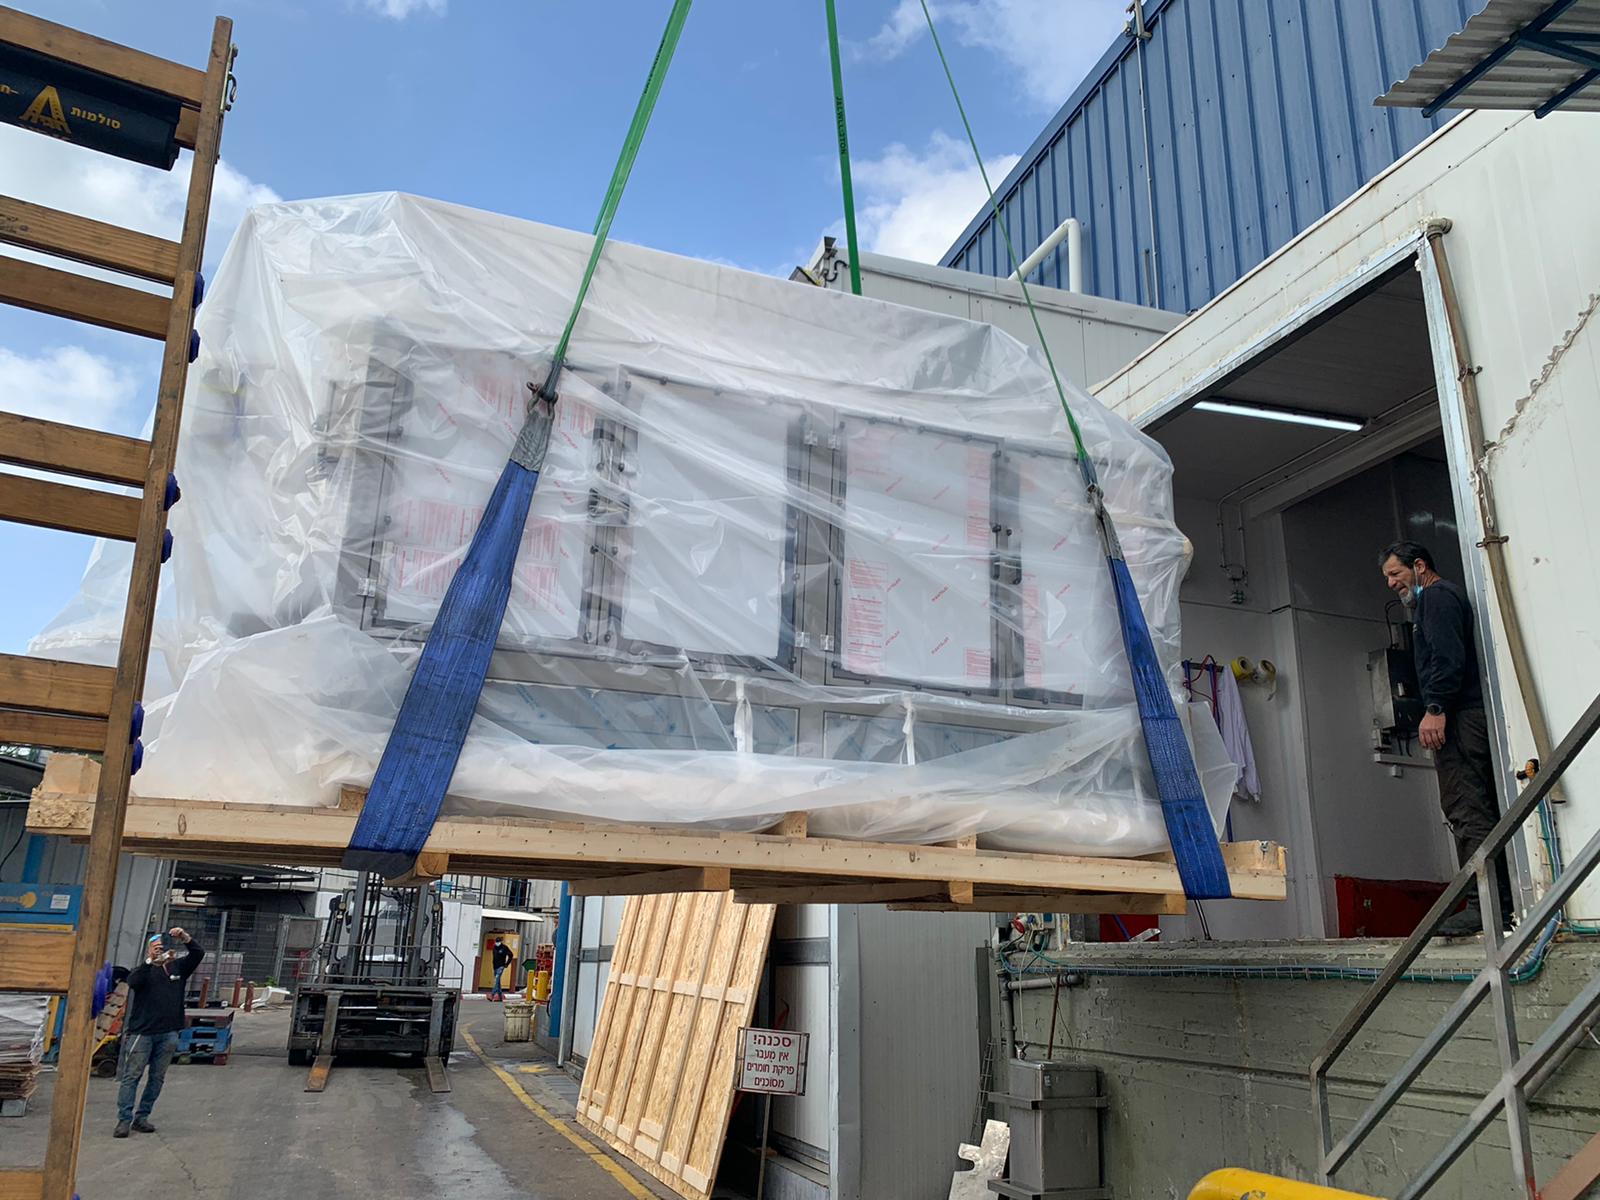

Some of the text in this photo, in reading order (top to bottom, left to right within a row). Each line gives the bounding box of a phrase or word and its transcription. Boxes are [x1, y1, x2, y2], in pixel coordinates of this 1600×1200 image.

[70, 106, 121, 129] סולמות
[753, 1034, 792, 1047] סכנה!
[755, 1049, 789, 1062] אין מעבר
[746, 1062, 794, 1076] פריקת חומרים
[754, 1077, 784, 1088] מסוכנים
